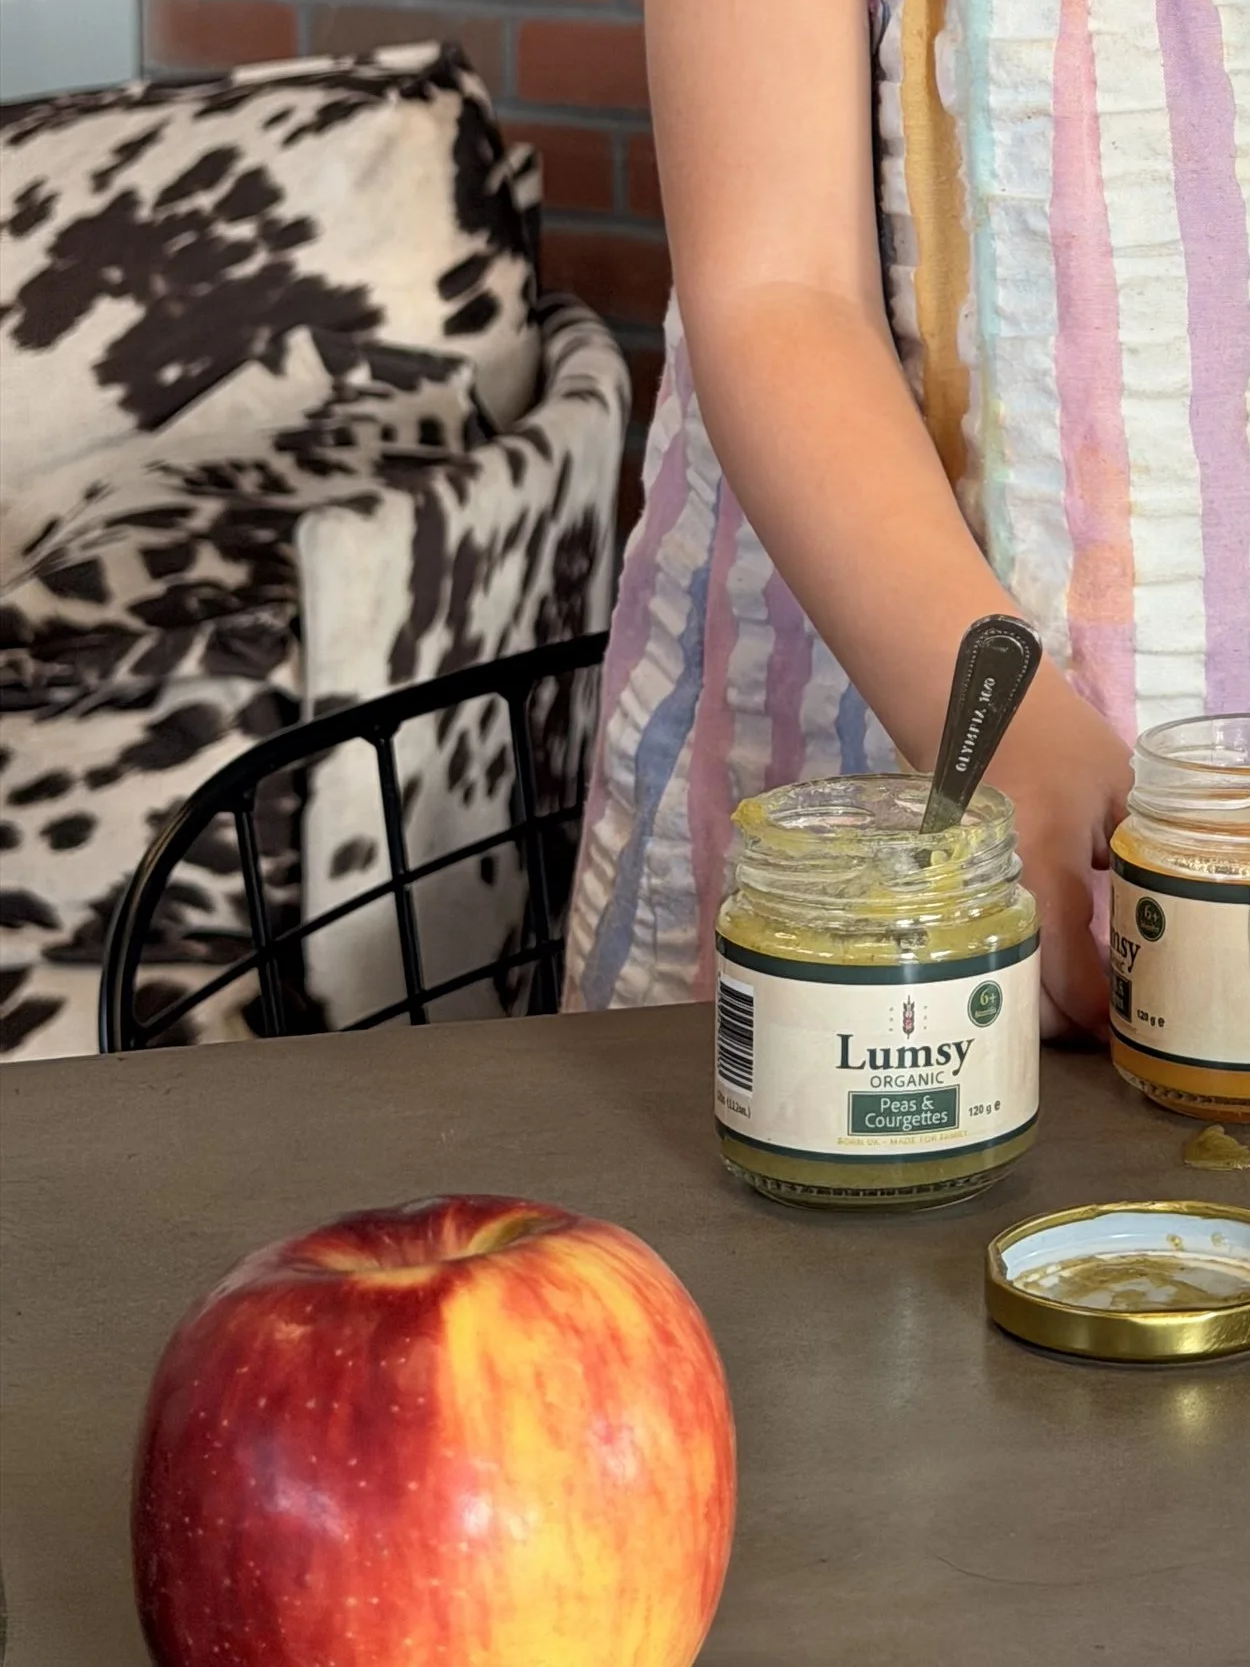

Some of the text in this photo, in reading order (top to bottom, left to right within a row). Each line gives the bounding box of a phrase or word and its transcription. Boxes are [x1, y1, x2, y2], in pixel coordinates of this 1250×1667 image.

[955, 708, 987, 772] OLYMPIA
[1110, 930, 1141, 974] msy
[980, 990, 996, 1006] 6+
[836, 1034, 975, 1076] Lumsy
[870, 1071, 945, 1088] ORGANIC
[880, 1095, 934, 1113] Peas &
[968, 1104, 984, 1116] 120
[986, 1104, 992, 1114] g
[865, 1111, 948, 1130] Courgettes
[890, 1136, 914, 1145] MADE
